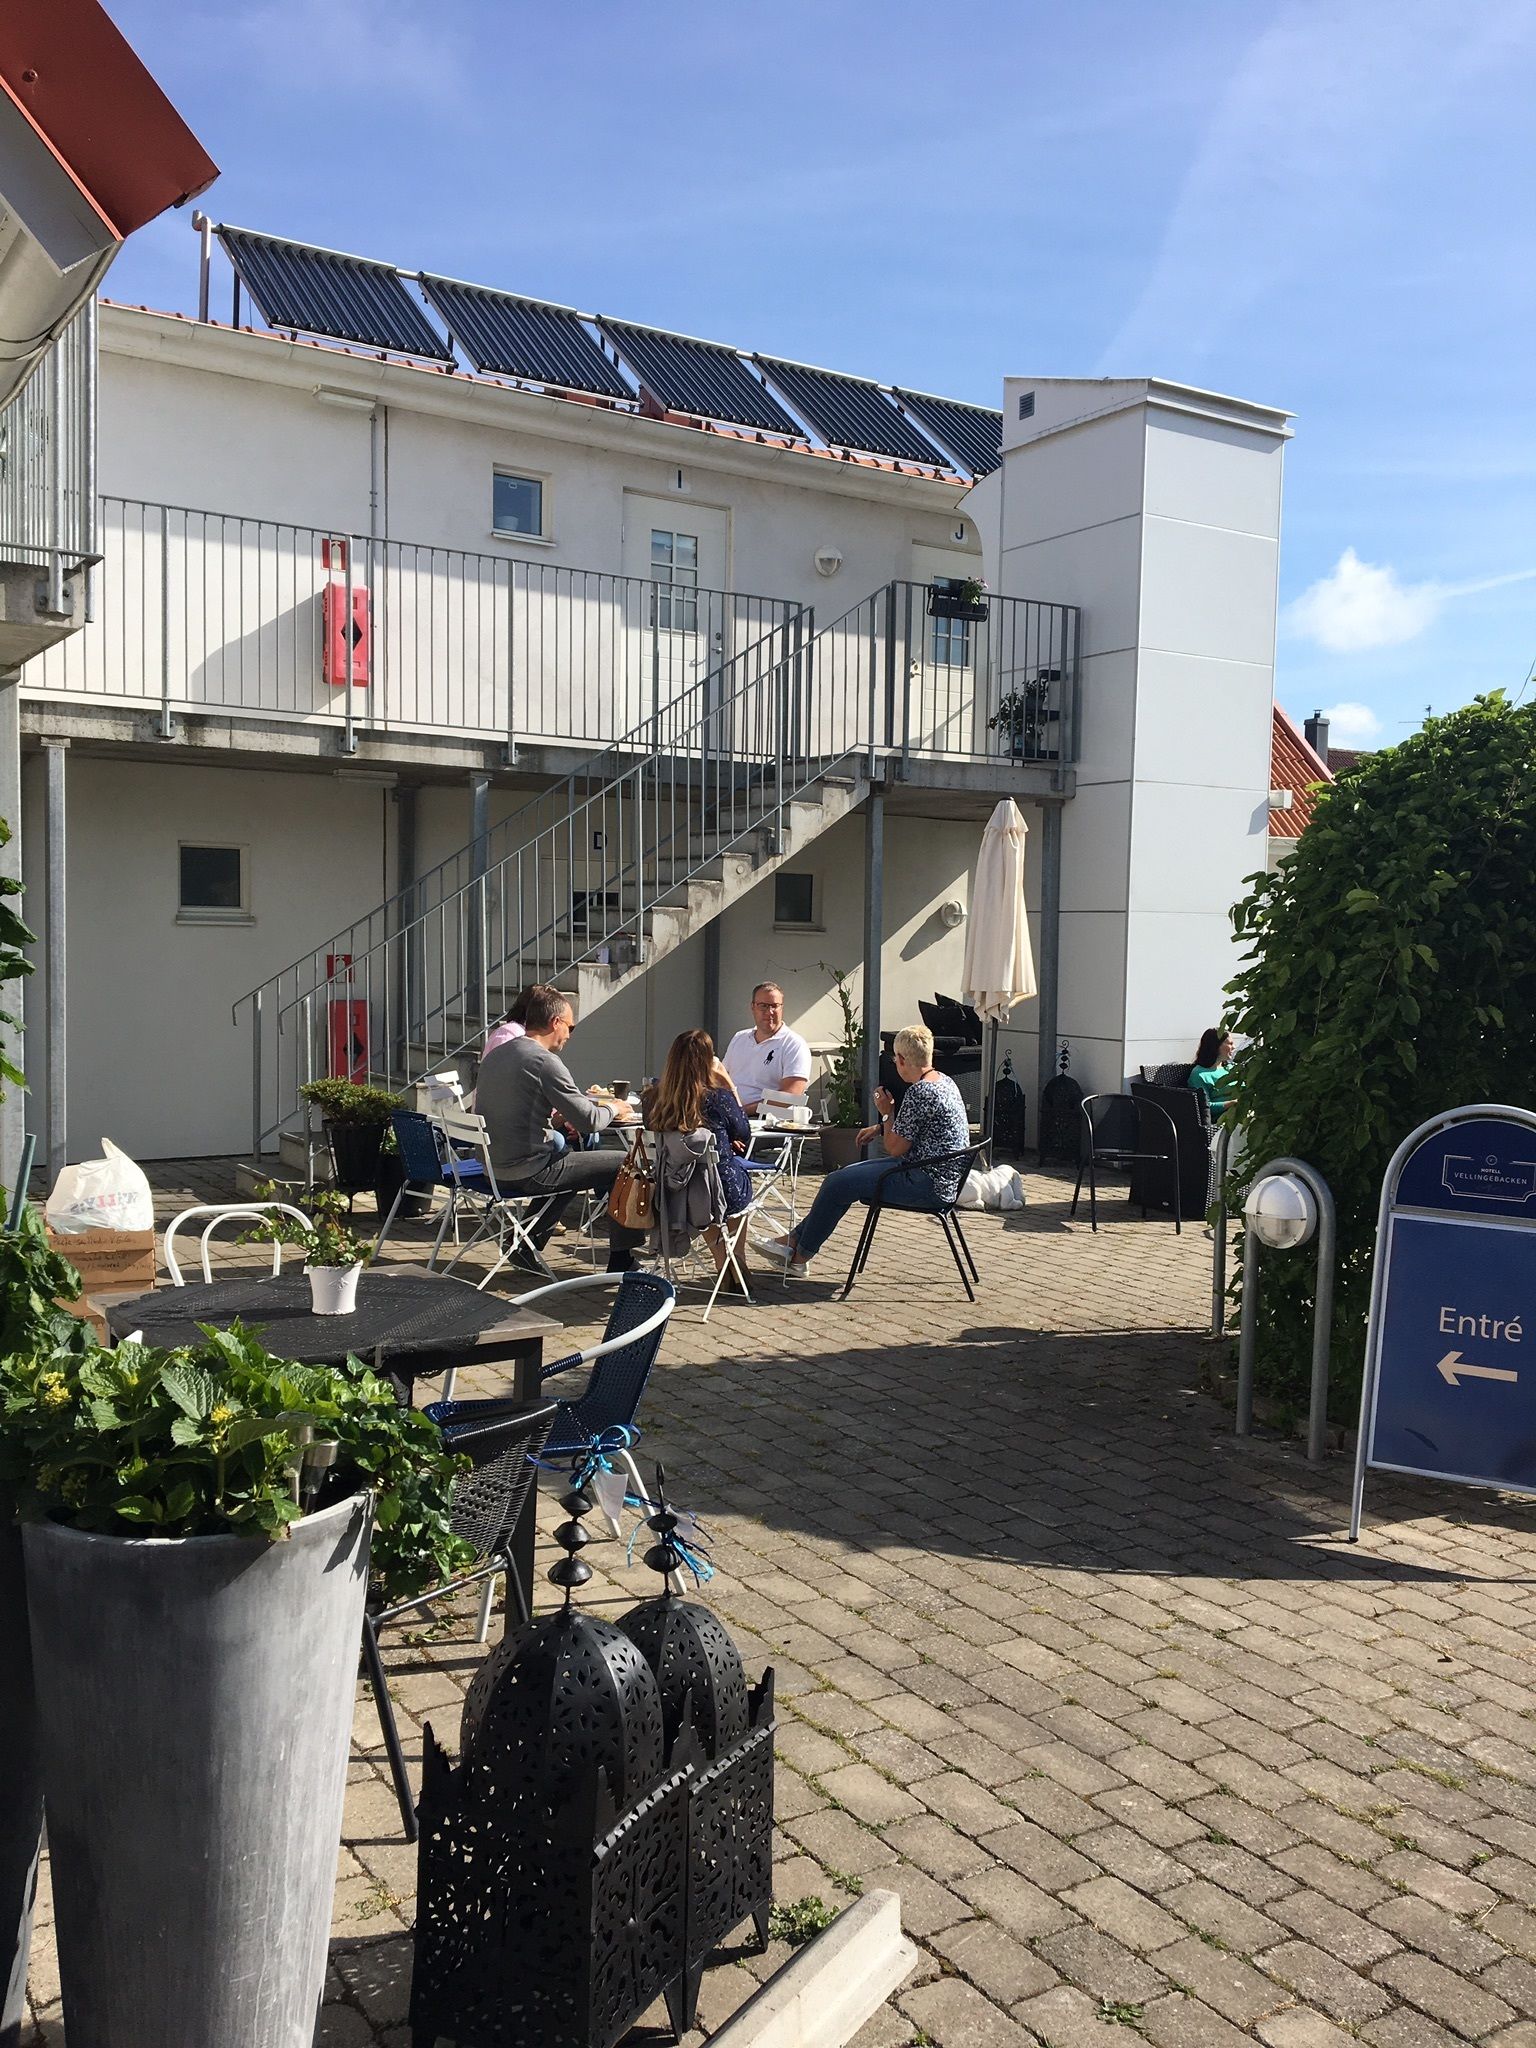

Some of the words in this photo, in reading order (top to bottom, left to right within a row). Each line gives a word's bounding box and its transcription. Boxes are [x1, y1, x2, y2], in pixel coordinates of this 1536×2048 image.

[954, 522, 964, 540] J
[1454, 1172, 1528, 1185] VELLINGEBACKEN
[1439, 1306, 1523, 1343] Entré
